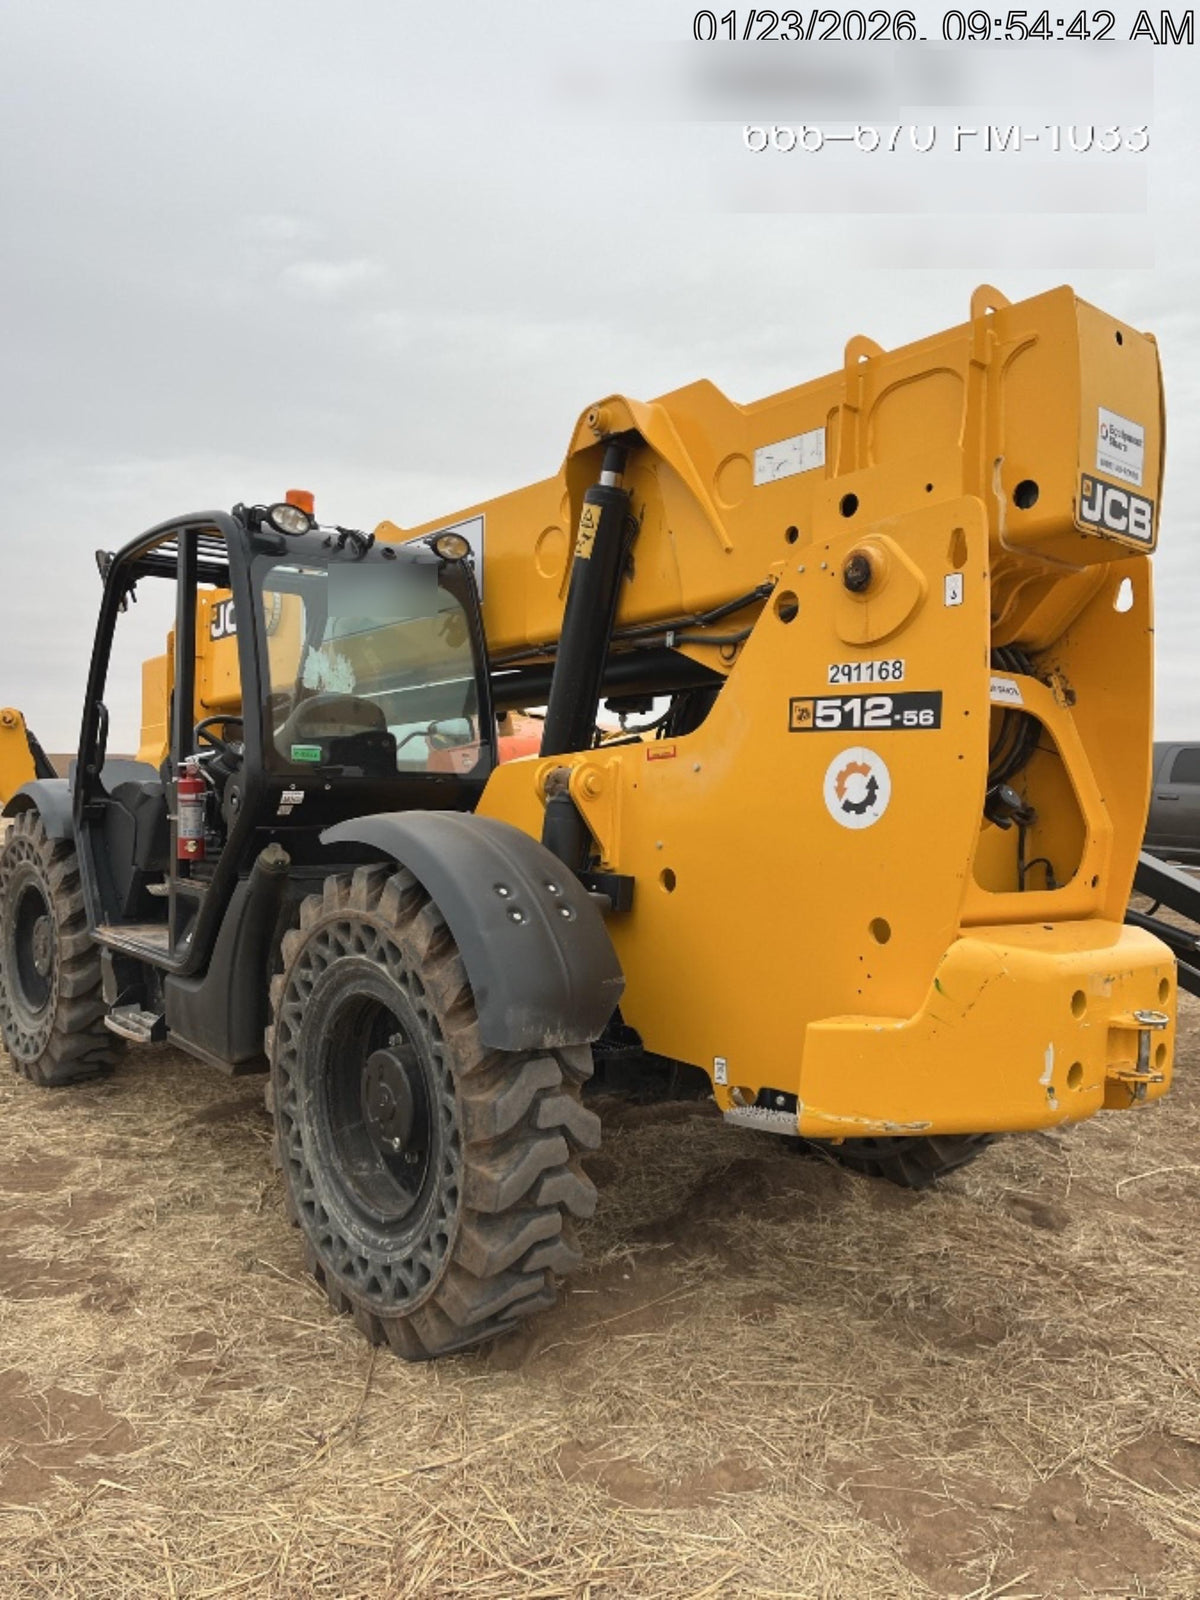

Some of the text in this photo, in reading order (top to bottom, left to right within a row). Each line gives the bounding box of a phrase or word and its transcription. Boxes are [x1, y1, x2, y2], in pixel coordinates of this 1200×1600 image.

[1081, 483, 1152, 540] JCB
[210, 600, 237, 638] JC
[829, 660, 903, 683] 291168
